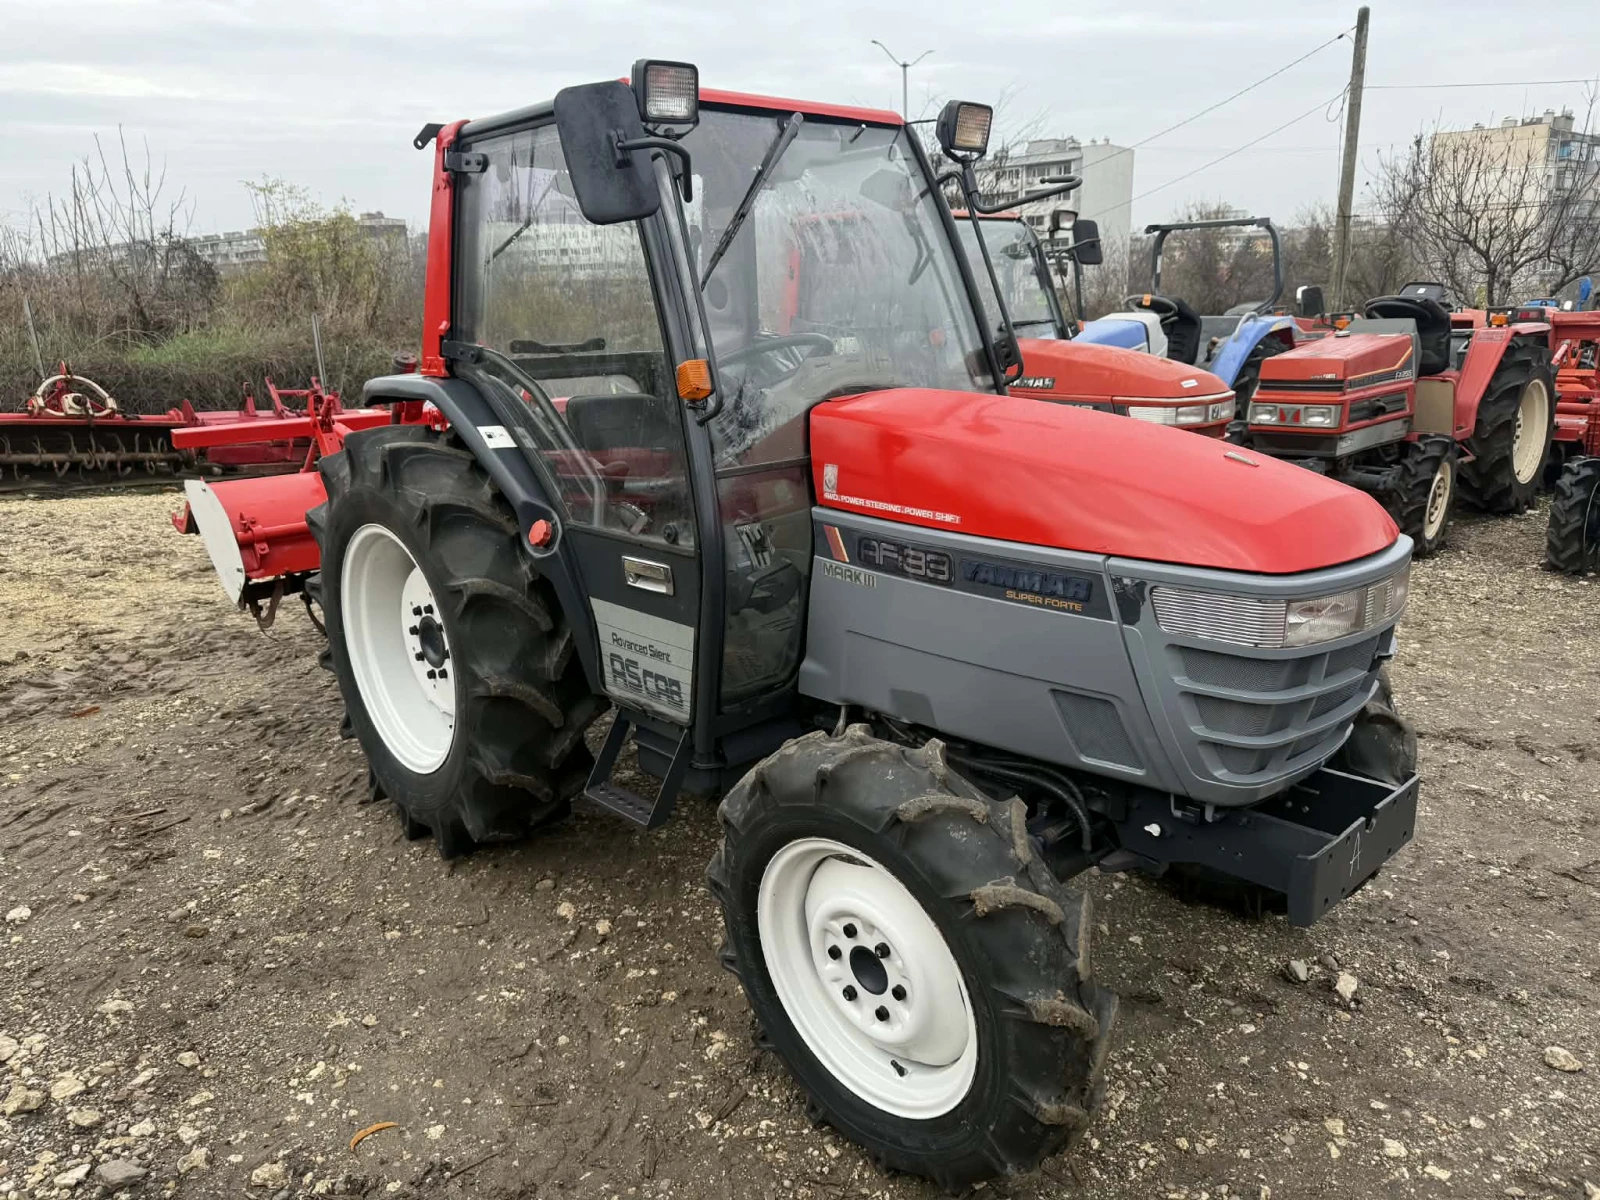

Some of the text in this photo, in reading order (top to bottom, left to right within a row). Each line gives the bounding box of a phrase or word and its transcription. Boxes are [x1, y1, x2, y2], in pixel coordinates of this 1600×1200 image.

[841, 495, 865, 507] POWER
[905, 507, 933, 519] POWER
[935, 513, 961, 524] SHIFT
[823, 562, 862, 583] MARK
[961, 560, 1093, 602] YANMAR
[1006, 590, 1082, 612] SUPER FORTE
[649, 644, 671, 662] Silent
[1349, 831, 1362, 877] A
